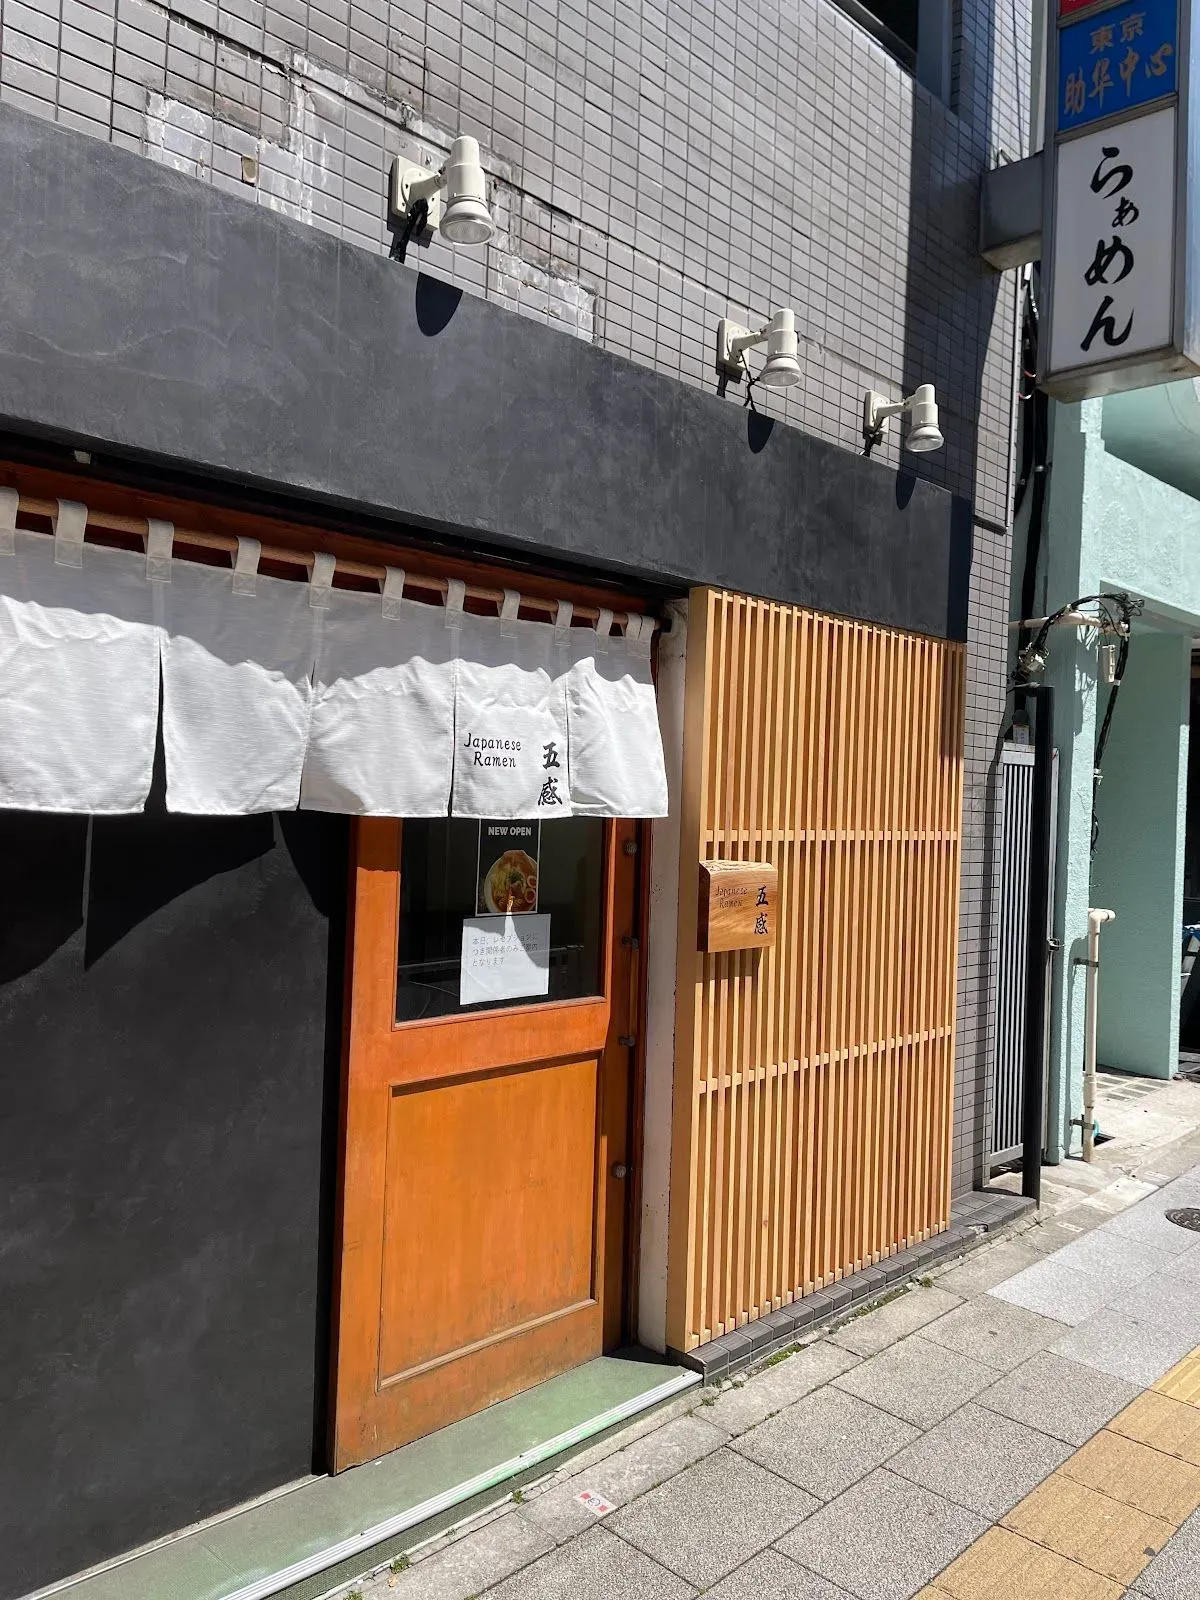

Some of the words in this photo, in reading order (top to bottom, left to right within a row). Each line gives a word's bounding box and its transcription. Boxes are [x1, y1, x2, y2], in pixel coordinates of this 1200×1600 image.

[1088, 12, 1147, 55] 東京
[1080, 146, 1140, 352] らぁめん
[463, 732, 522, 752] Japanese
[473, 751, 517, 768] Ramen
[537, 741, 563, 806] 五感
[487, 826, 509, 836] NEW
[509, 826, 532, 836] OPEN
[715, 885, 748, 897] Japanese
[719, 897, 744, 909] Ramen
[753, 884, 769, 935] 五感
